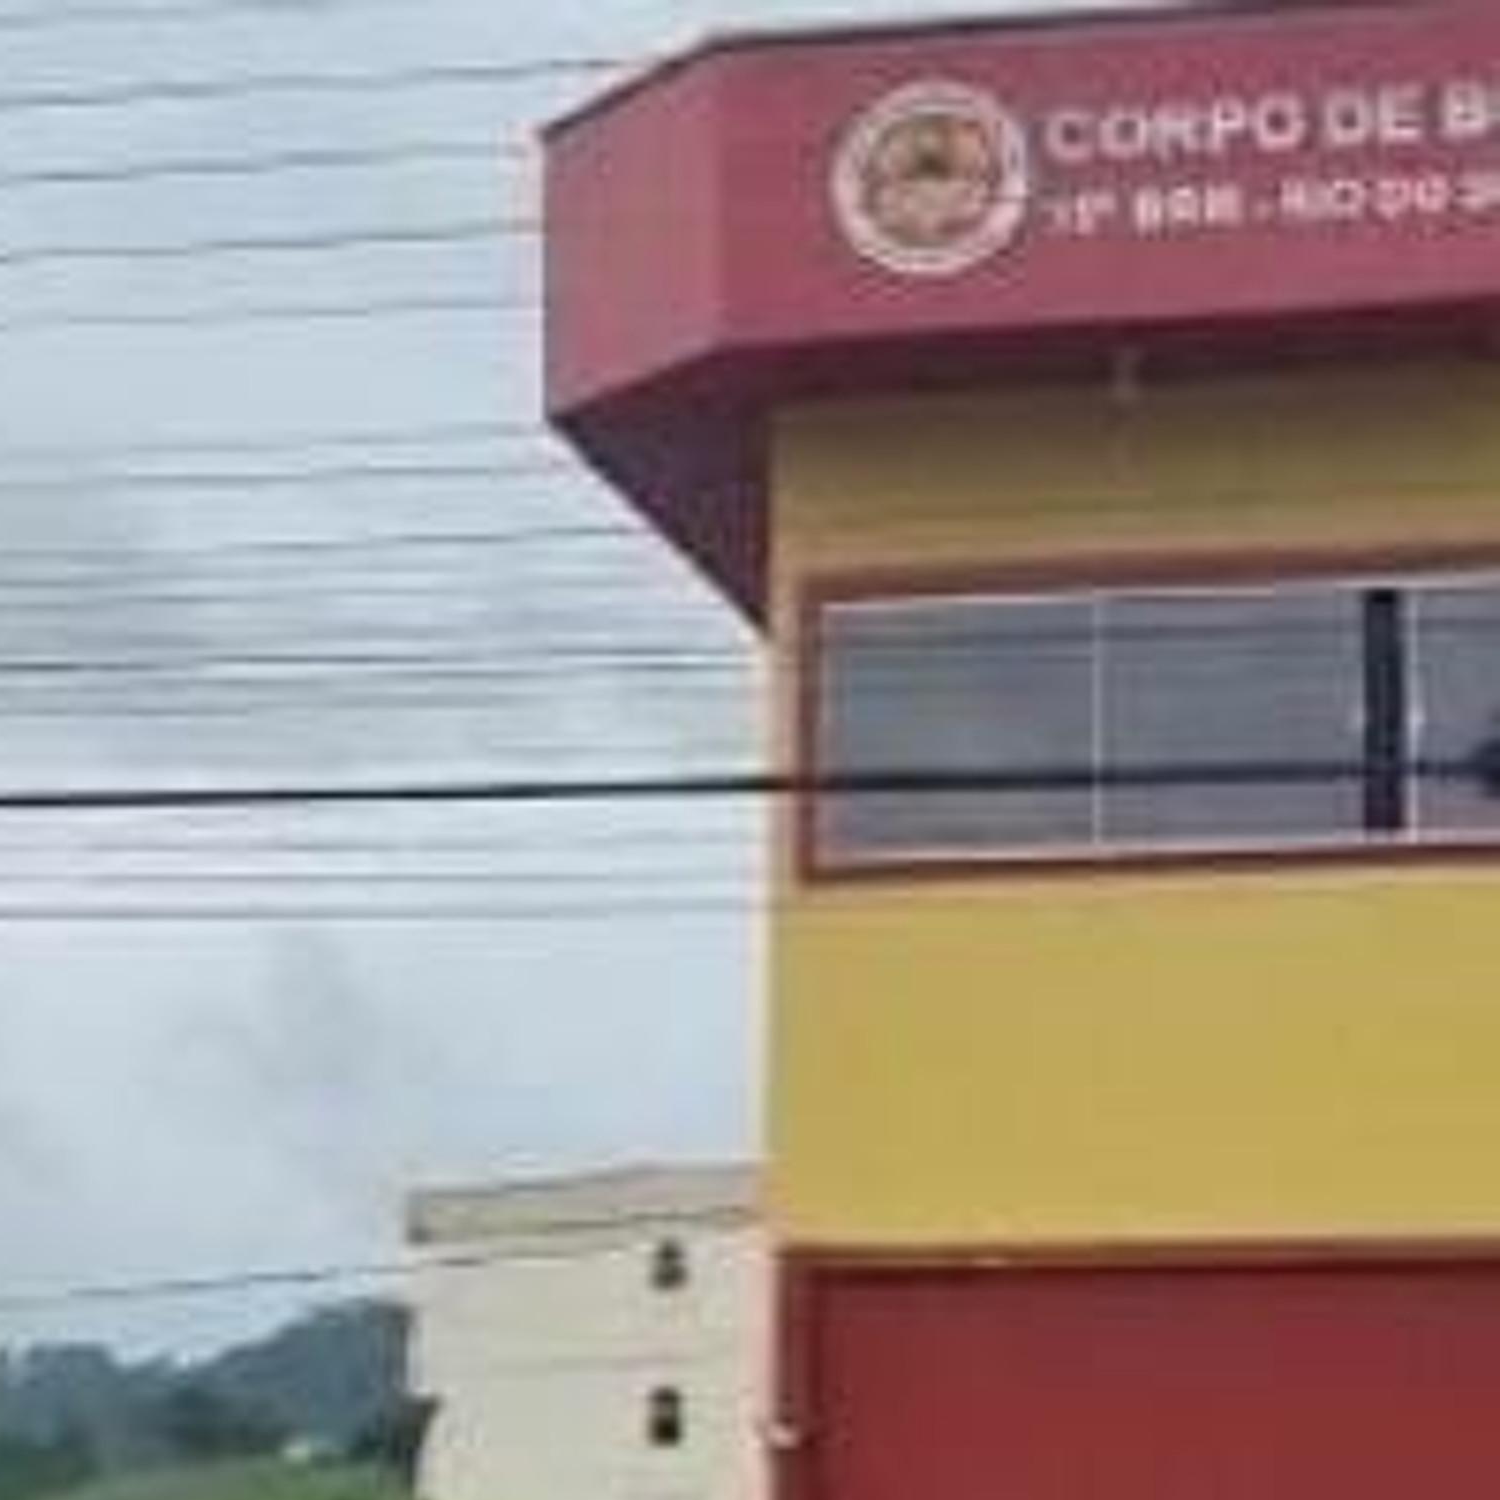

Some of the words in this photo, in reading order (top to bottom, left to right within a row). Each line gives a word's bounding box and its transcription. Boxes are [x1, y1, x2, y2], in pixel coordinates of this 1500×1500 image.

[1044, 97, 1304, 163] CORPO
[1322, 89, 1424, 147] DE
[1440, 81, 1500, 137] B
